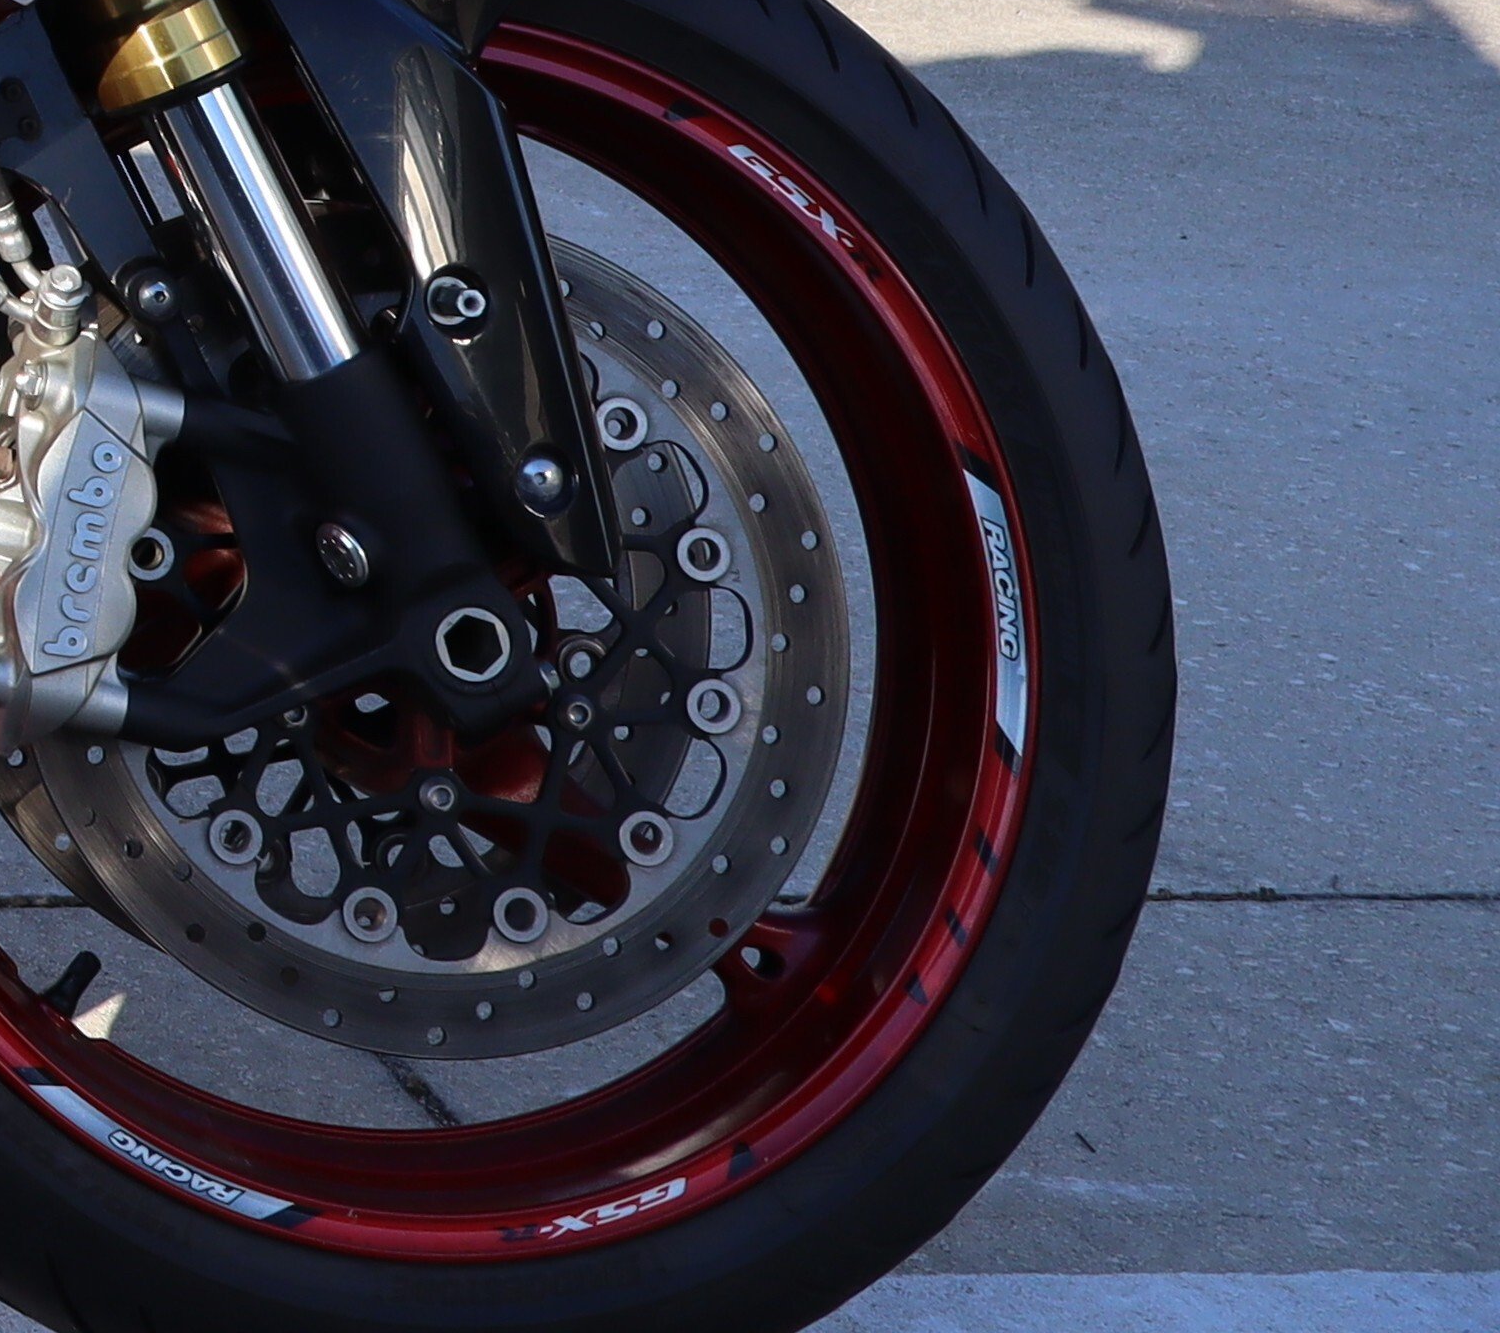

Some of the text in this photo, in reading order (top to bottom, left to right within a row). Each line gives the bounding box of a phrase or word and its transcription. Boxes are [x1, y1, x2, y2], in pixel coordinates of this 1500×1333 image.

[41, 440, 124, 658] brembo
[980, 516, 1019, 661] RACING
[106, 1129, 248, 1206] RACING
